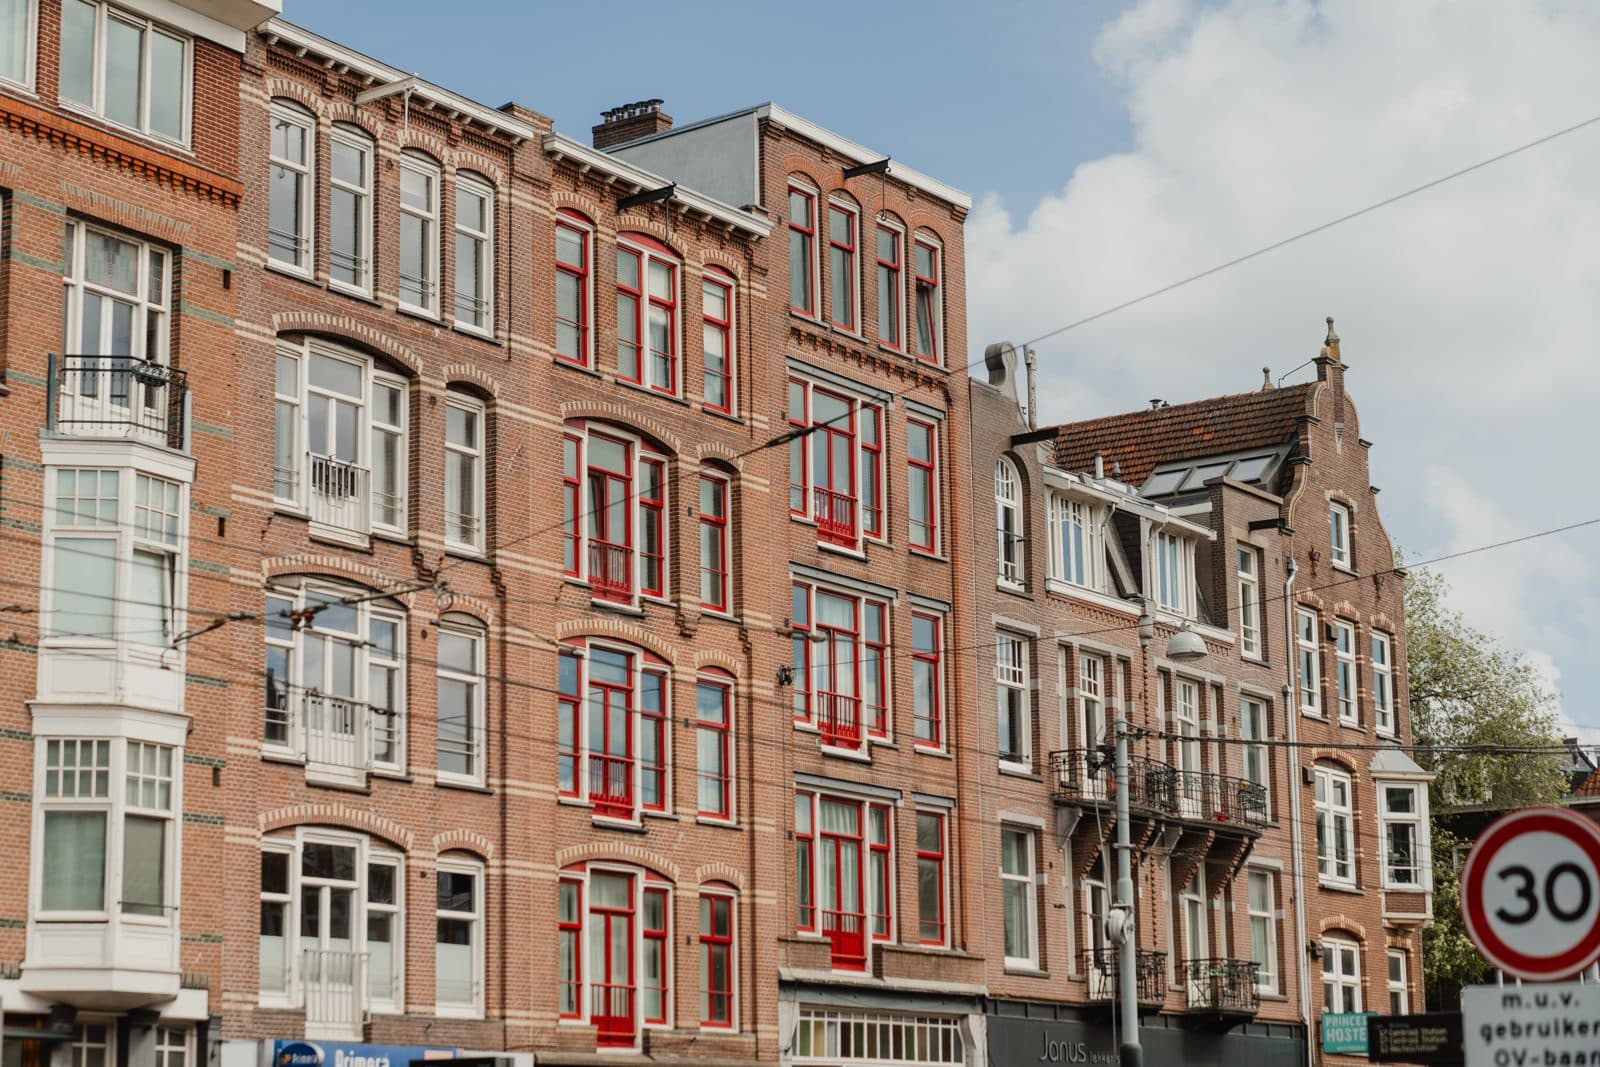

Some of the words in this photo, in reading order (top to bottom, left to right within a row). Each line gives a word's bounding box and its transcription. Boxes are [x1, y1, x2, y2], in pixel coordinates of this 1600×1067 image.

[1496, 862, 1592, 925] 30
[1502, 991, 1580, 1009] m.u.v.
[1480, 1018, 1600, 1045] gebruiker
[1039, 1031, 1087, 1063] Janus
[1494, 1048, 1600, 1067] OV-baan
